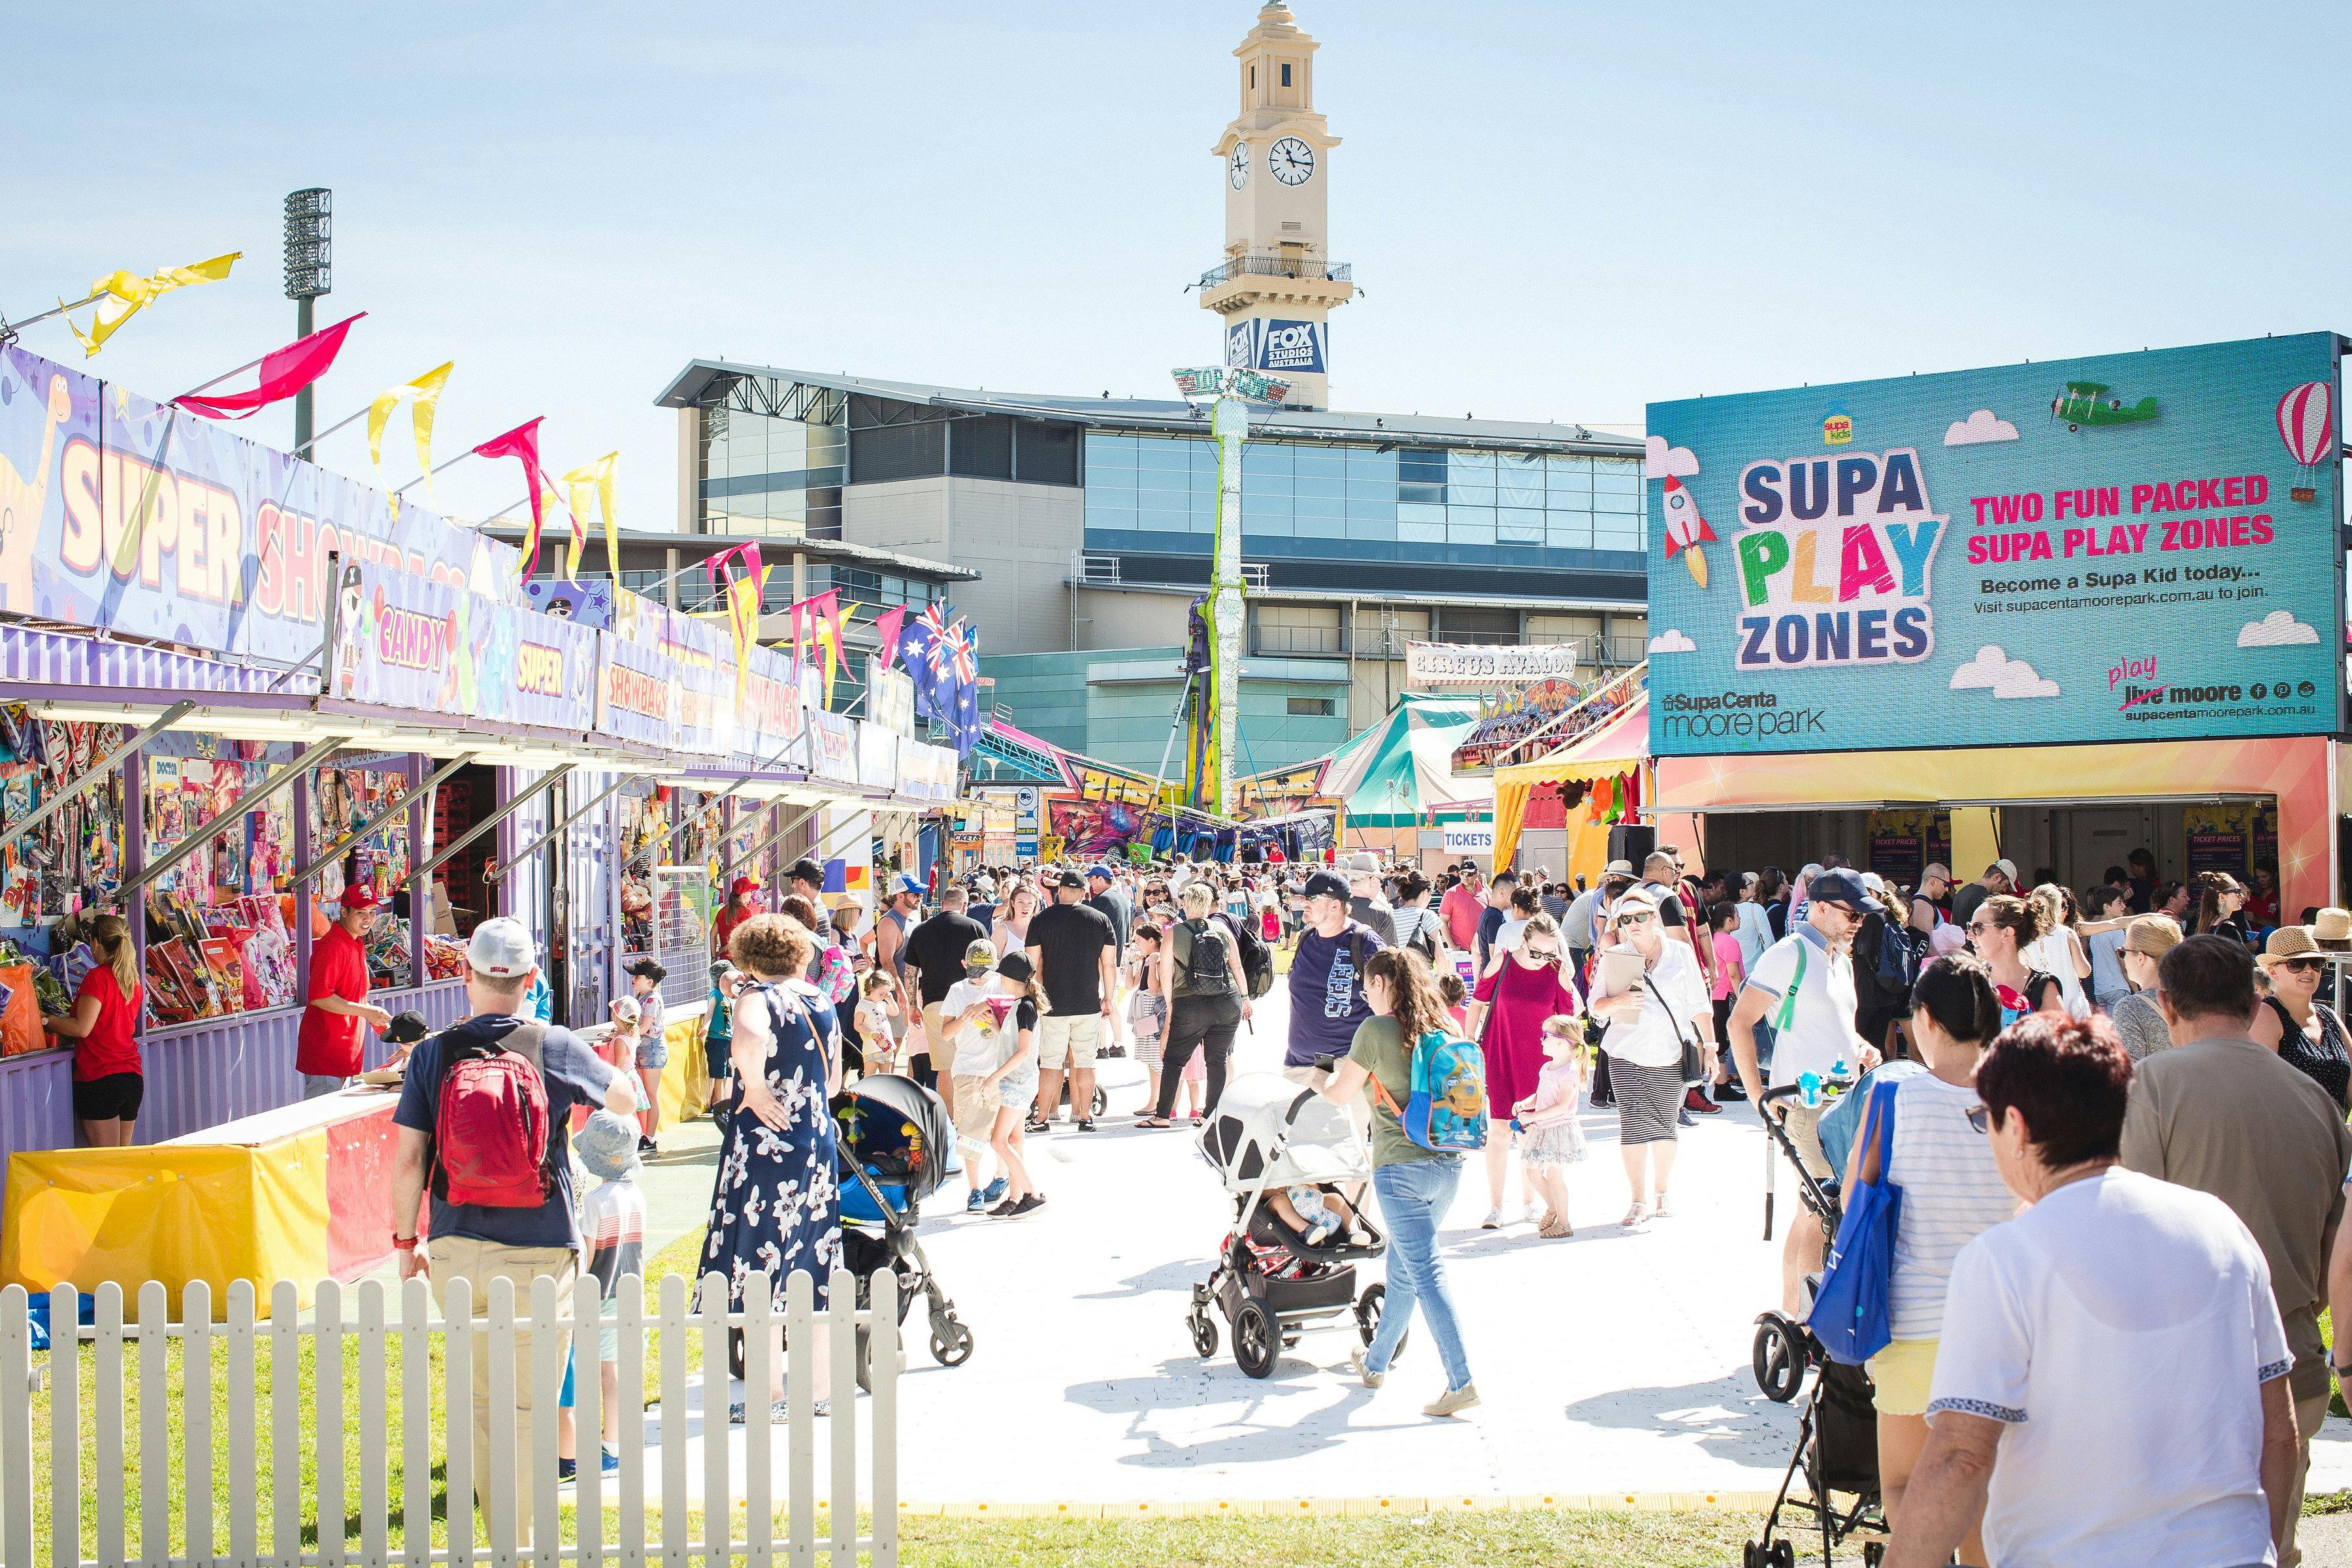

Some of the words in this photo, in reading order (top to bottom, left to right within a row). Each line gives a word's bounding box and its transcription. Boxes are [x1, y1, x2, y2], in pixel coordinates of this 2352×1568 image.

[1230, 322, 1249, 357] FOX
[1268, 323, 1313, 350] FOX
[1268, 347, 1313, 359] STUDIOS
[1268, 357, 1313, 367] AUSTRALIA
[1744, 453, 1924, 524] SUPA
[1970, 492, 2044, 527] TWO
[2054, 487, 2120, 521] FUN
[2131, 474, 2269, 514] PACKED
[62, 436, 243, 608] SUPER
[1967, 535, 2053, 564] SUPA
[2063, 523, 2149, 558] PLAY
[2160, 514, 2274, 551] ZONES
[1737, 521, 1940, 607] PLAY
[1980, 575, 2061, 595] Become
[2070, 577, 2079, 589] a
[2085, 572, 2136, 591] Supa
[2143, 567, 2178, 584] Kid
[2184, 564, 2261, 585] today...
[1974, 600, 2004, 614] Visit
[2006, 587, 2214, 613] supacentamoorepark.com.au
[2217, 587, 2234, 599] to
[2237, 585, 2270, 601] join.
[378, 606, 448, 672] CANDY
[1740, 608, 1929, 664] ZONES
[517, 640, 564, 698] SUPER
[1413, 653, 1494, 676] CIRCUS
[1500, 653, 1575, 675] AVALON
[2108, 655, 2156, 691] play
[608, 662, 669, 721] SHOWBAGS
[2125, 685, 2164, 704] live
[2170, 685, 2242, 704] moore
[1663, 713, 1754, 738] moore
[1757, 708, 1827, 742] park
[2125, 704, 2316, 723] supacentamoorepark.com.au
[1083, 771, 1106, 802] 2
[1444, 832, 1492, 846] TICKETS
[1324, 949, 1355, 1018] LEEDS
